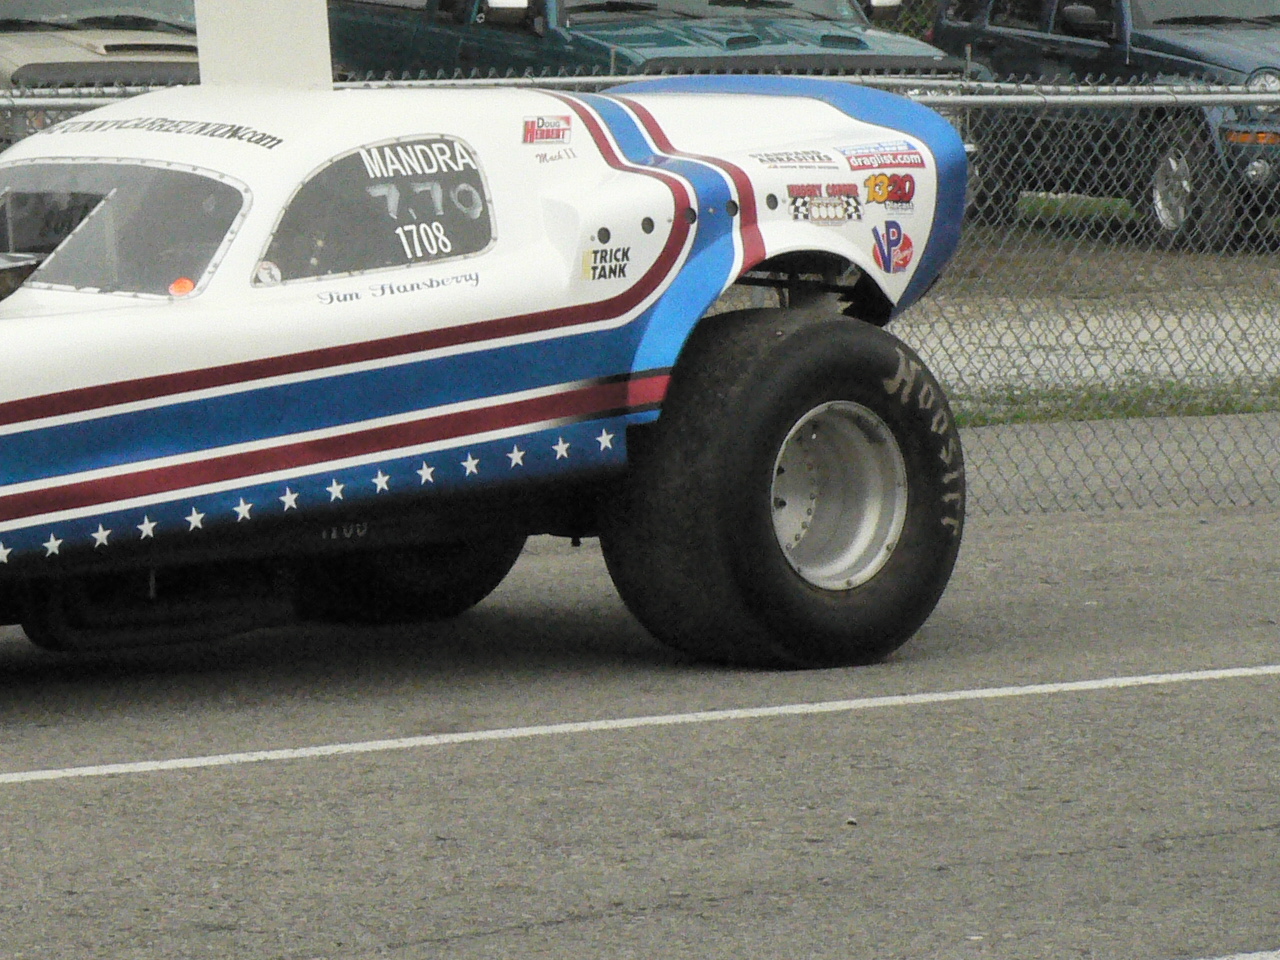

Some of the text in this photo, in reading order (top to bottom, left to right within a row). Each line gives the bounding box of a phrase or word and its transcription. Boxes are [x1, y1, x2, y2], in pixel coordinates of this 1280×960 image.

[358, 140, 478, 179] MANDRA
[395, 221, 452, 259] 1708
[591, 246, 631, 265] TRICK
[590, 262, 627, 281] TANK
